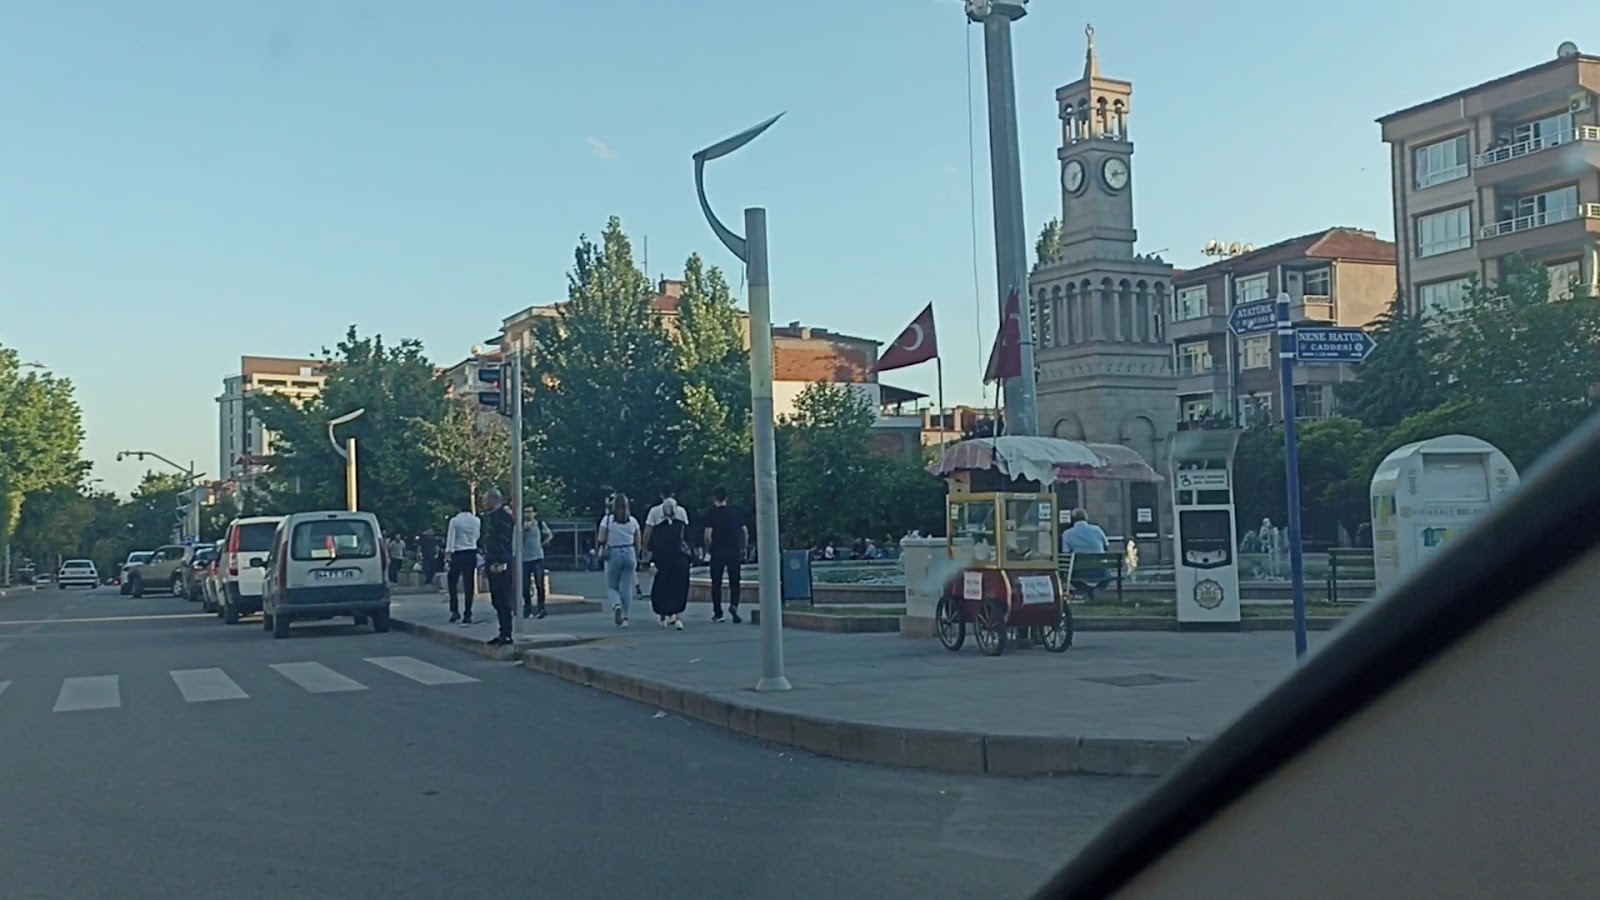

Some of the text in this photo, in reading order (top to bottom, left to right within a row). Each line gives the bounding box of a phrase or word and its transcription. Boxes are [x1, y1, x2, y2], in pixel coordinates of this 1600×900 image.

[1237, 304, 1272, 318] ATATÜRK
[1298, 332, 1364, 341] NENE HATUN
[1310, 342, 1352, 351] CADDESİ
